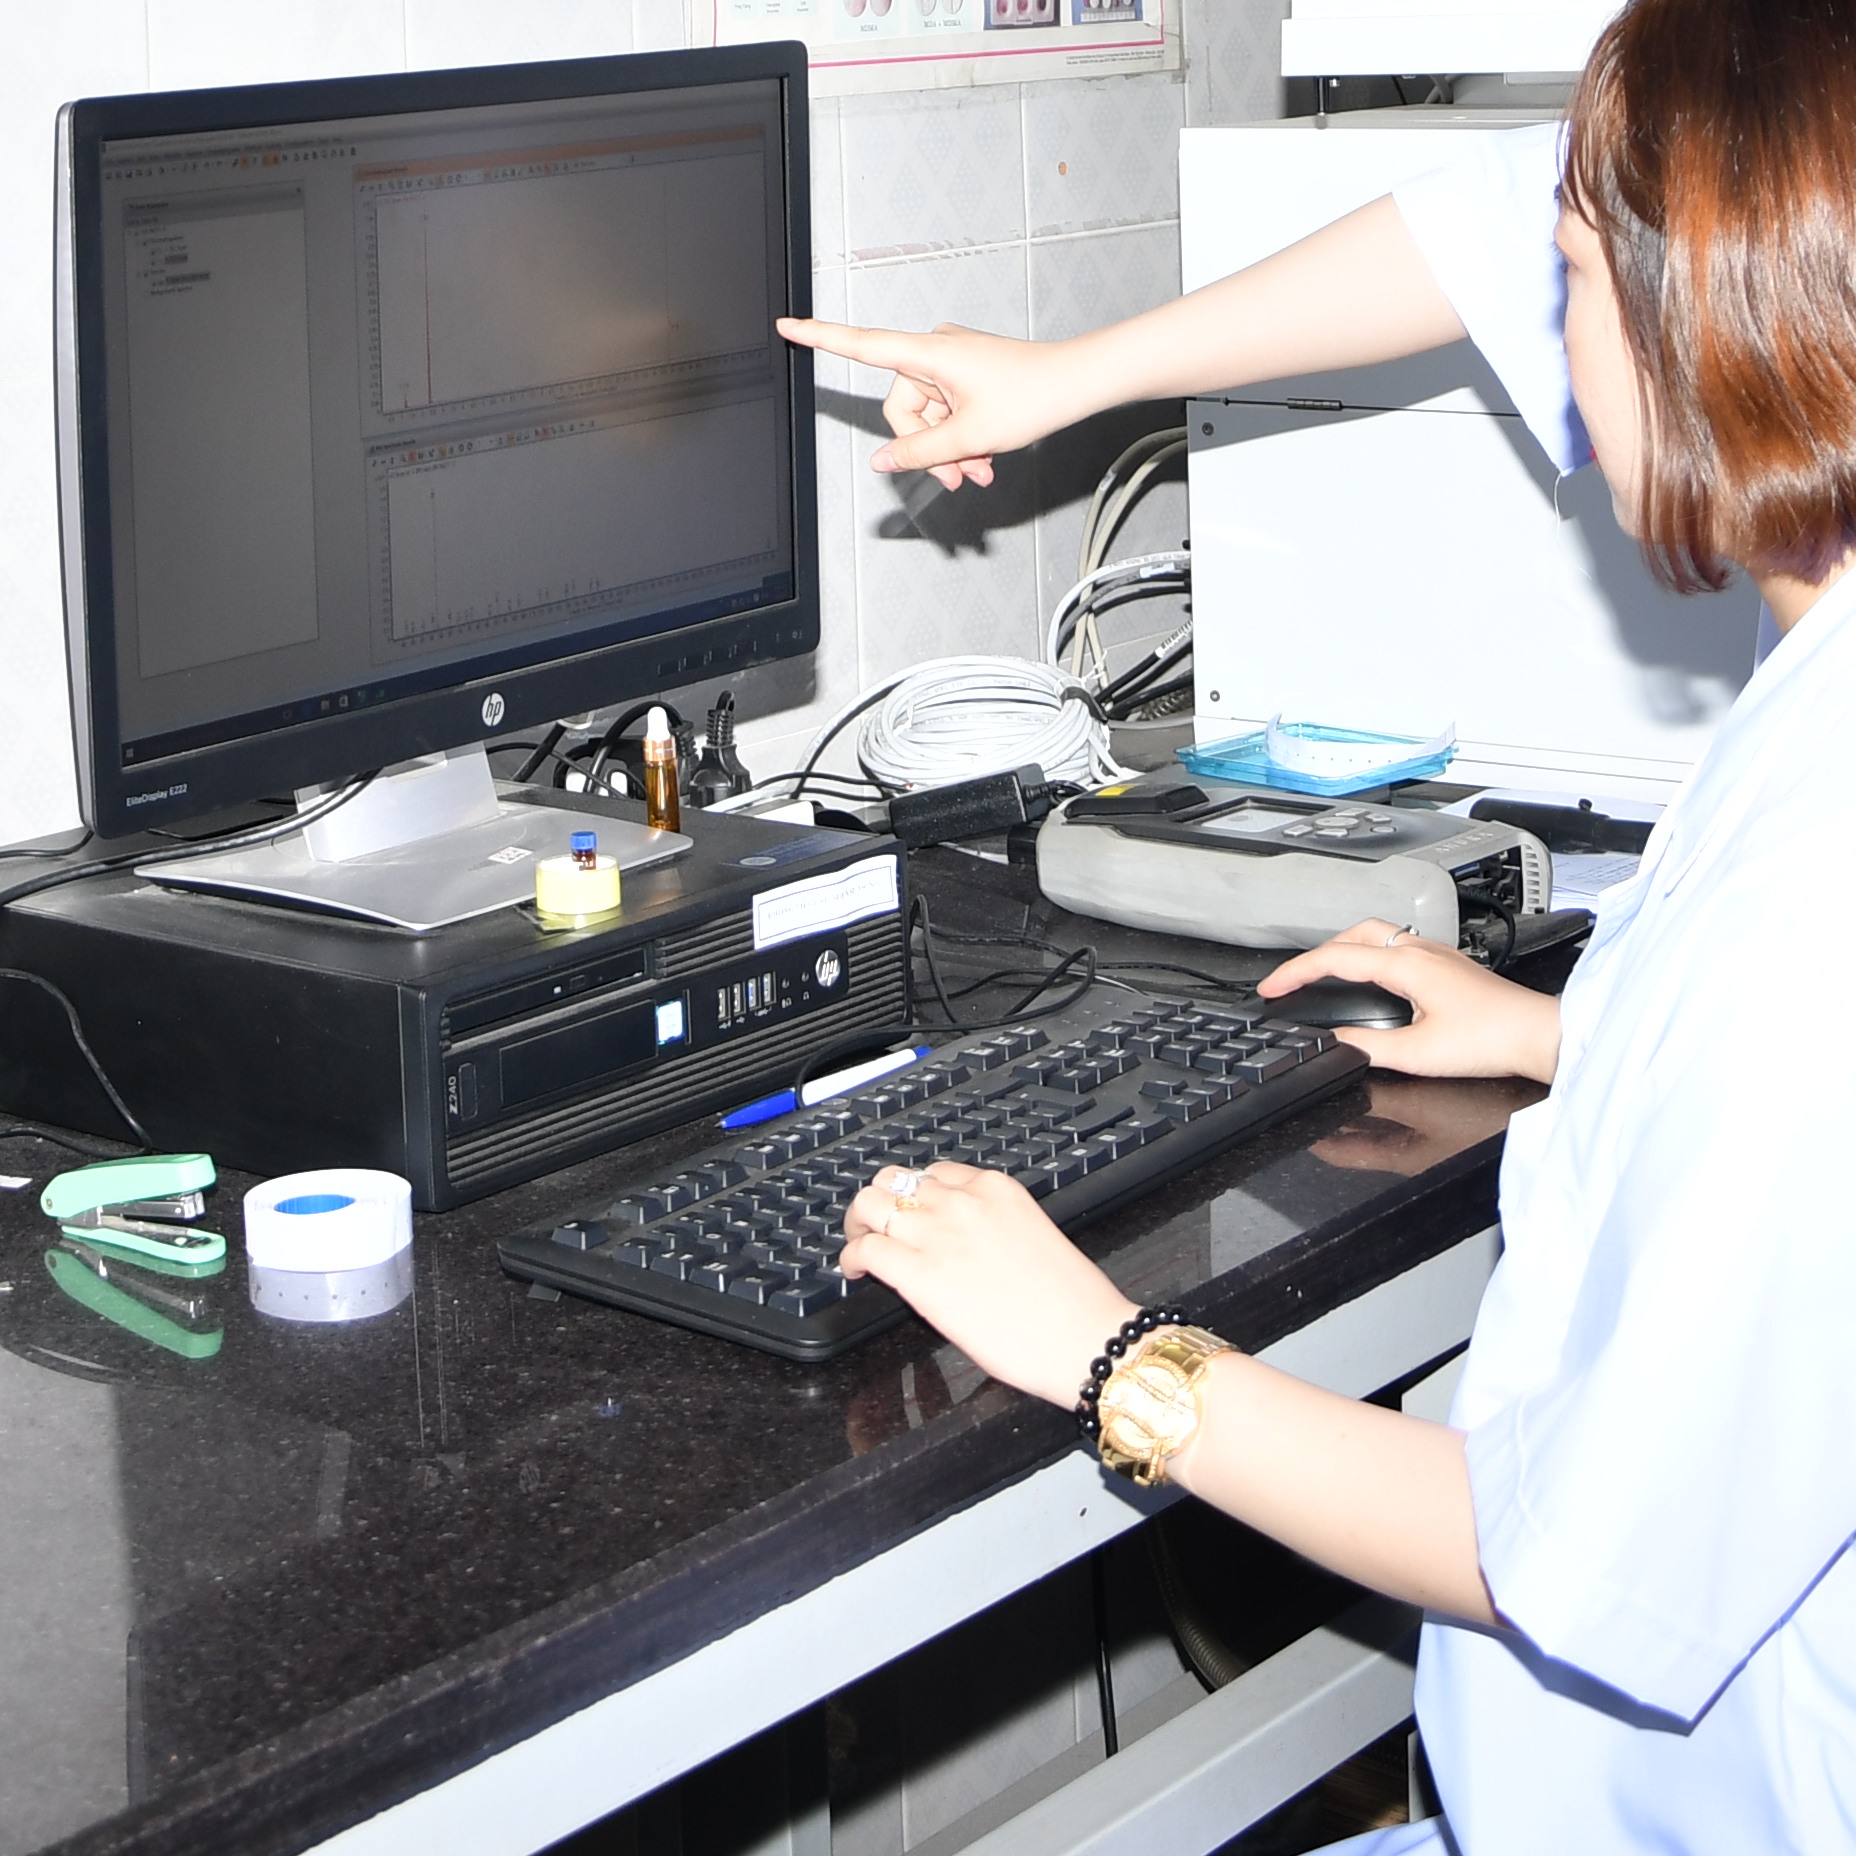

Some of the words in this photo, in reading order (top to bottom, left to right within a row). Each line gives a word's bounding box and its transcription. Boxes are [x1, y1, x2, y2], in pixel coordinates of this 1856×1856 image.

[482, 692, 505, 727] hp
[125, 788, 168, 807] EliteDisplay
[169, 783, 188, 796] E222
[815, 949, 841, 987] hp
[448, 1075, 459, 1115] Z240
